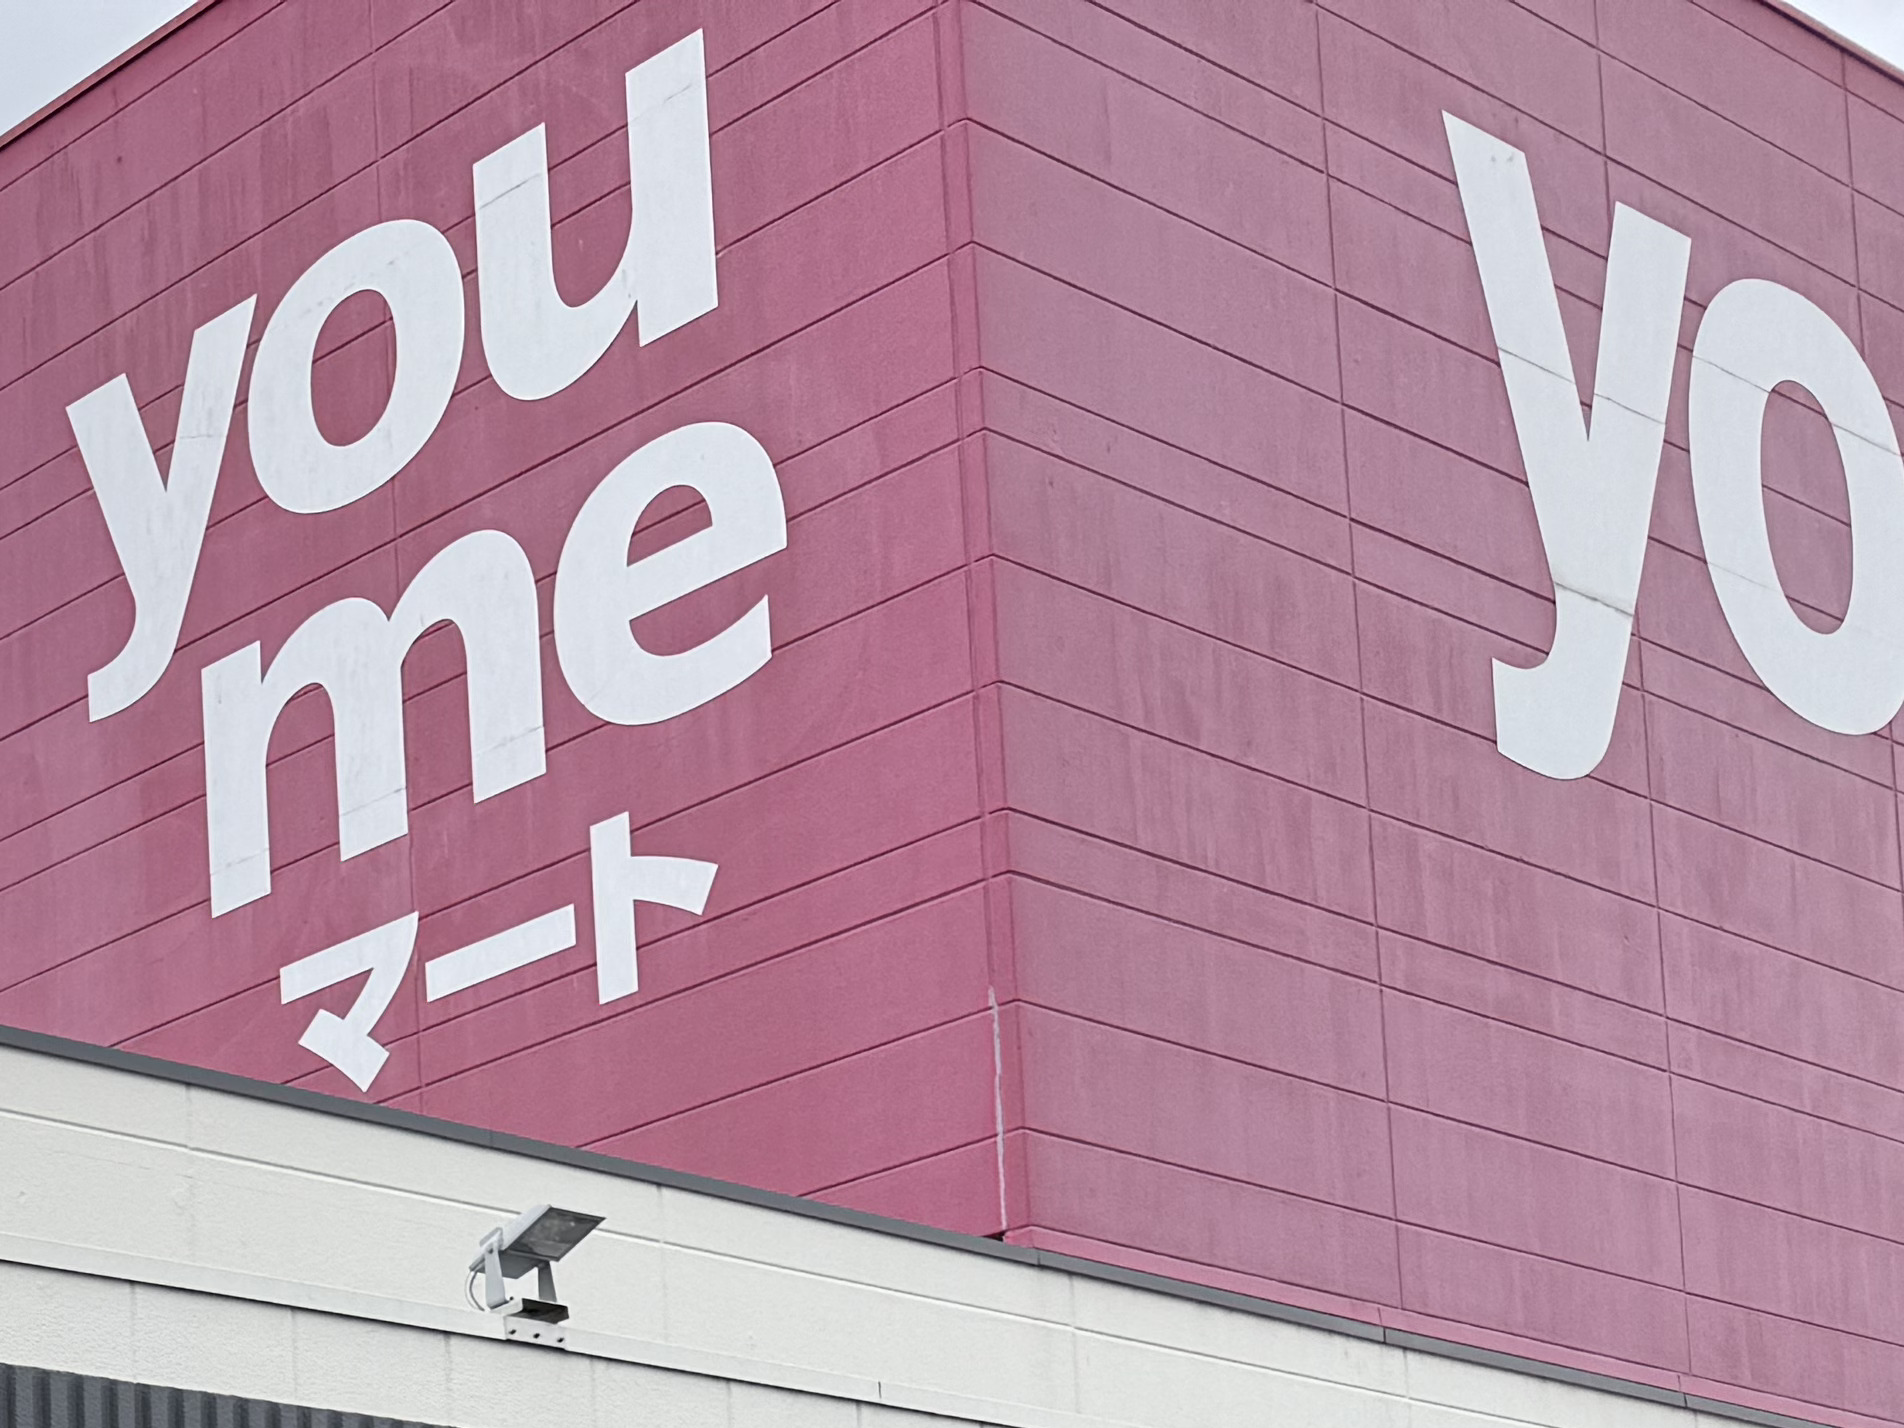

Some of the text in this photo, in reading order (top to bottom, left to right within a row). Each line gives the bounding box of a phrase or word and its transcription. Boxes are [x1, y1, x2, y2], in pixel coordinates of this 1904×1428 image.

[64, 27, 720, 723] you
[199, 420, 788, 919] me
[278, 809, 719, 1092] マート
